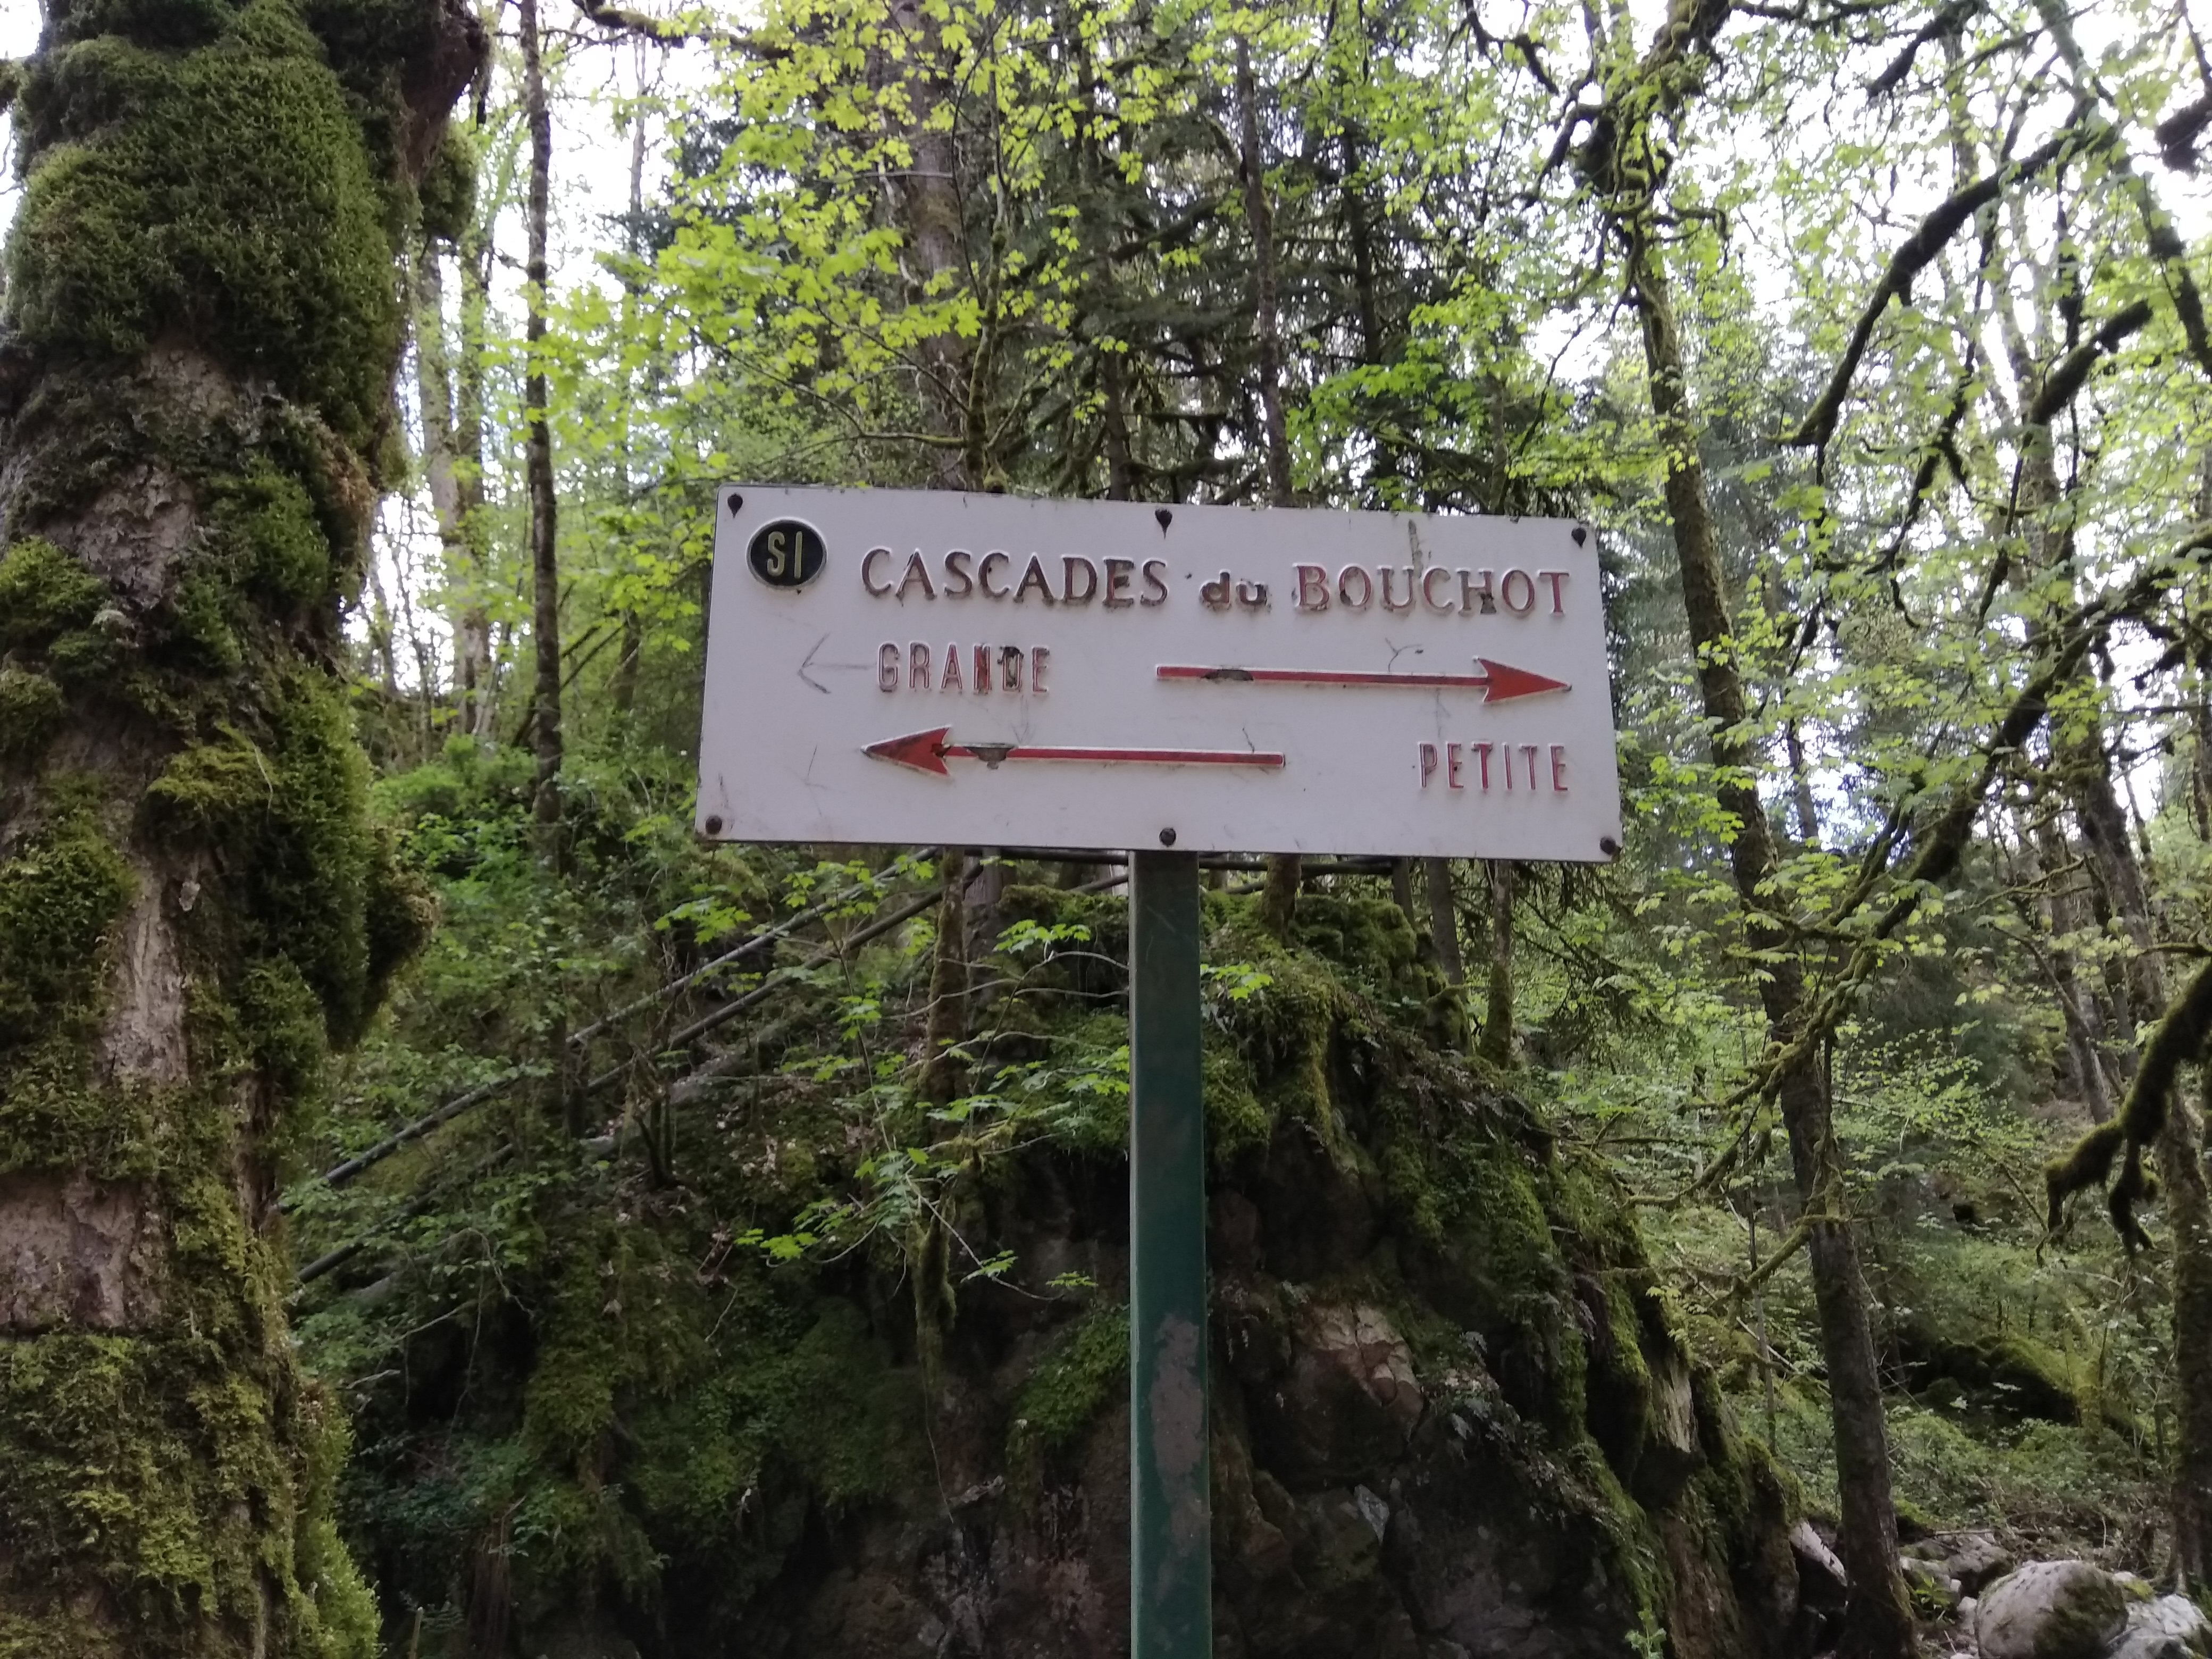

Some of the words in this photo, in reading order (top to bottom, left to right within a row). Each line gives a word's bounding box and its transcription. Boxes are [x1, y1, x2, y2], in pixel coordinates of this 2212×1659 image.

[767, 531, 803, 580] SI
[861, 547, 1168, 607] CASCADES
[1200, 569, 1267, 610] du
[1293, 563, 1570, 616] BOUCHOT
[877, 642, 1050, 694] GRANDE
[1418, 742, 1569, 792] PETITE
